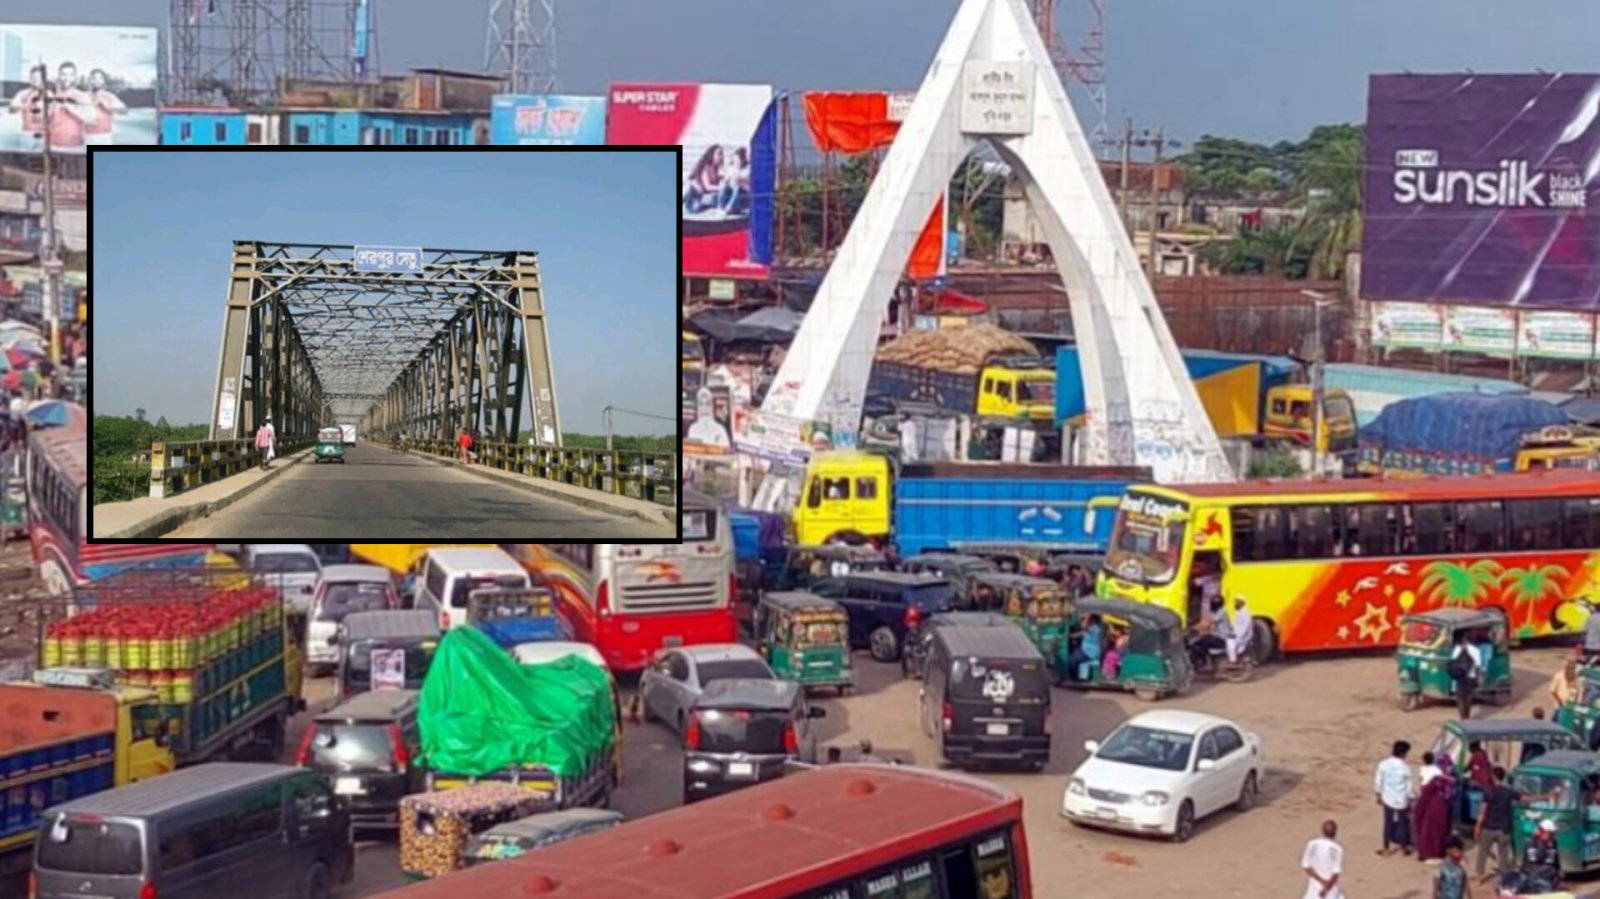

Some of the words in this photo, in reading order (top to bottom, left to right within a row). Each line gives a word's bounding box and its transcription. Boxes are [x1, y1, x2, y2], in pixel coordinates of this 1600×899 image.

[1394, 160, 1545, 206] sunsilk
[1550, 172, 1582, 189] black
[1549, 190, 1587, 207] SHINE
[356, 251, 394, 269] শেরপুর
